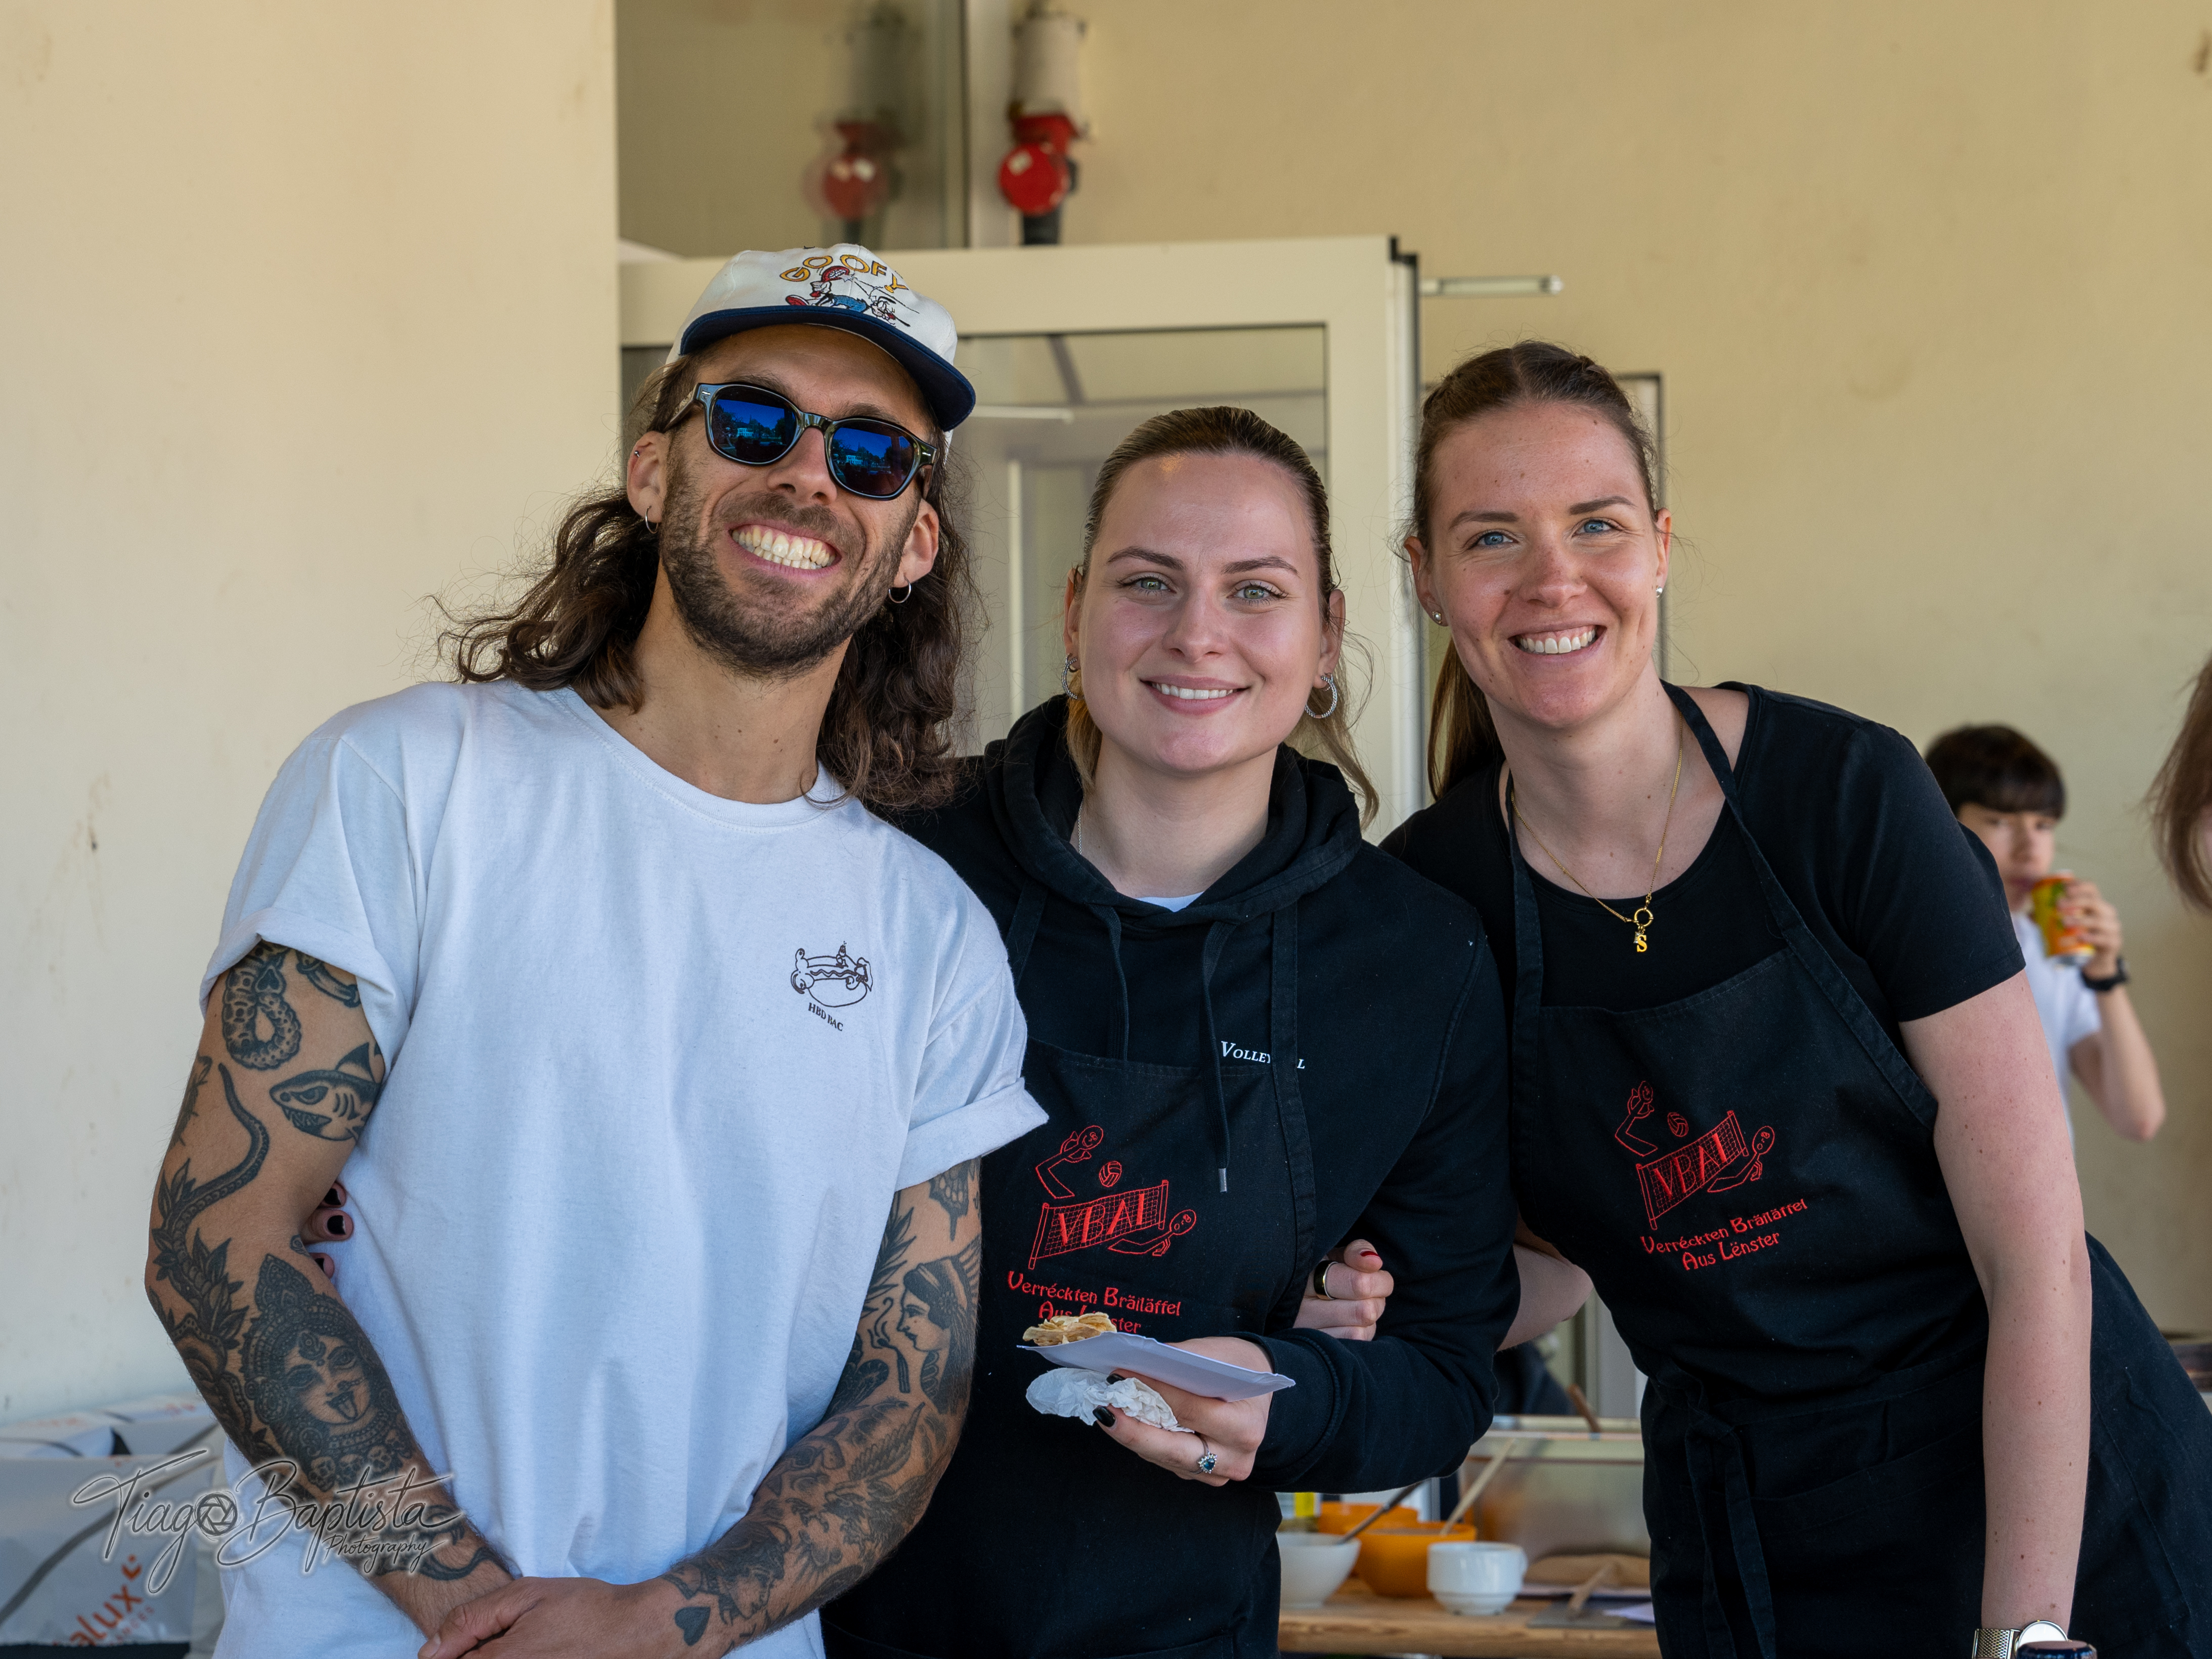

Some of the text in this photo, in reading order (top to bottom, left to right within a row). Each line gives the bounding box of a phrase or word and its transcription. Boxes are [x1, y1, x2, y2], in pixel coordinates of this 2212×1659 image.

[779, 254, 909, 293] GOOFY
[1637, 935, 1647, 952] S
[808, 1002, 827, 1020] HBD
[1640, 1228, 1729, 1254] Verréckten
[1682, 1233, 1780, 1271] Aus Lënster
[1007, 1271, 1181, 1316] Verréckten Bräiläffel
[1079, 1304, 1141, 1333] Lster
[53, 1584, 144, 1646] alux
